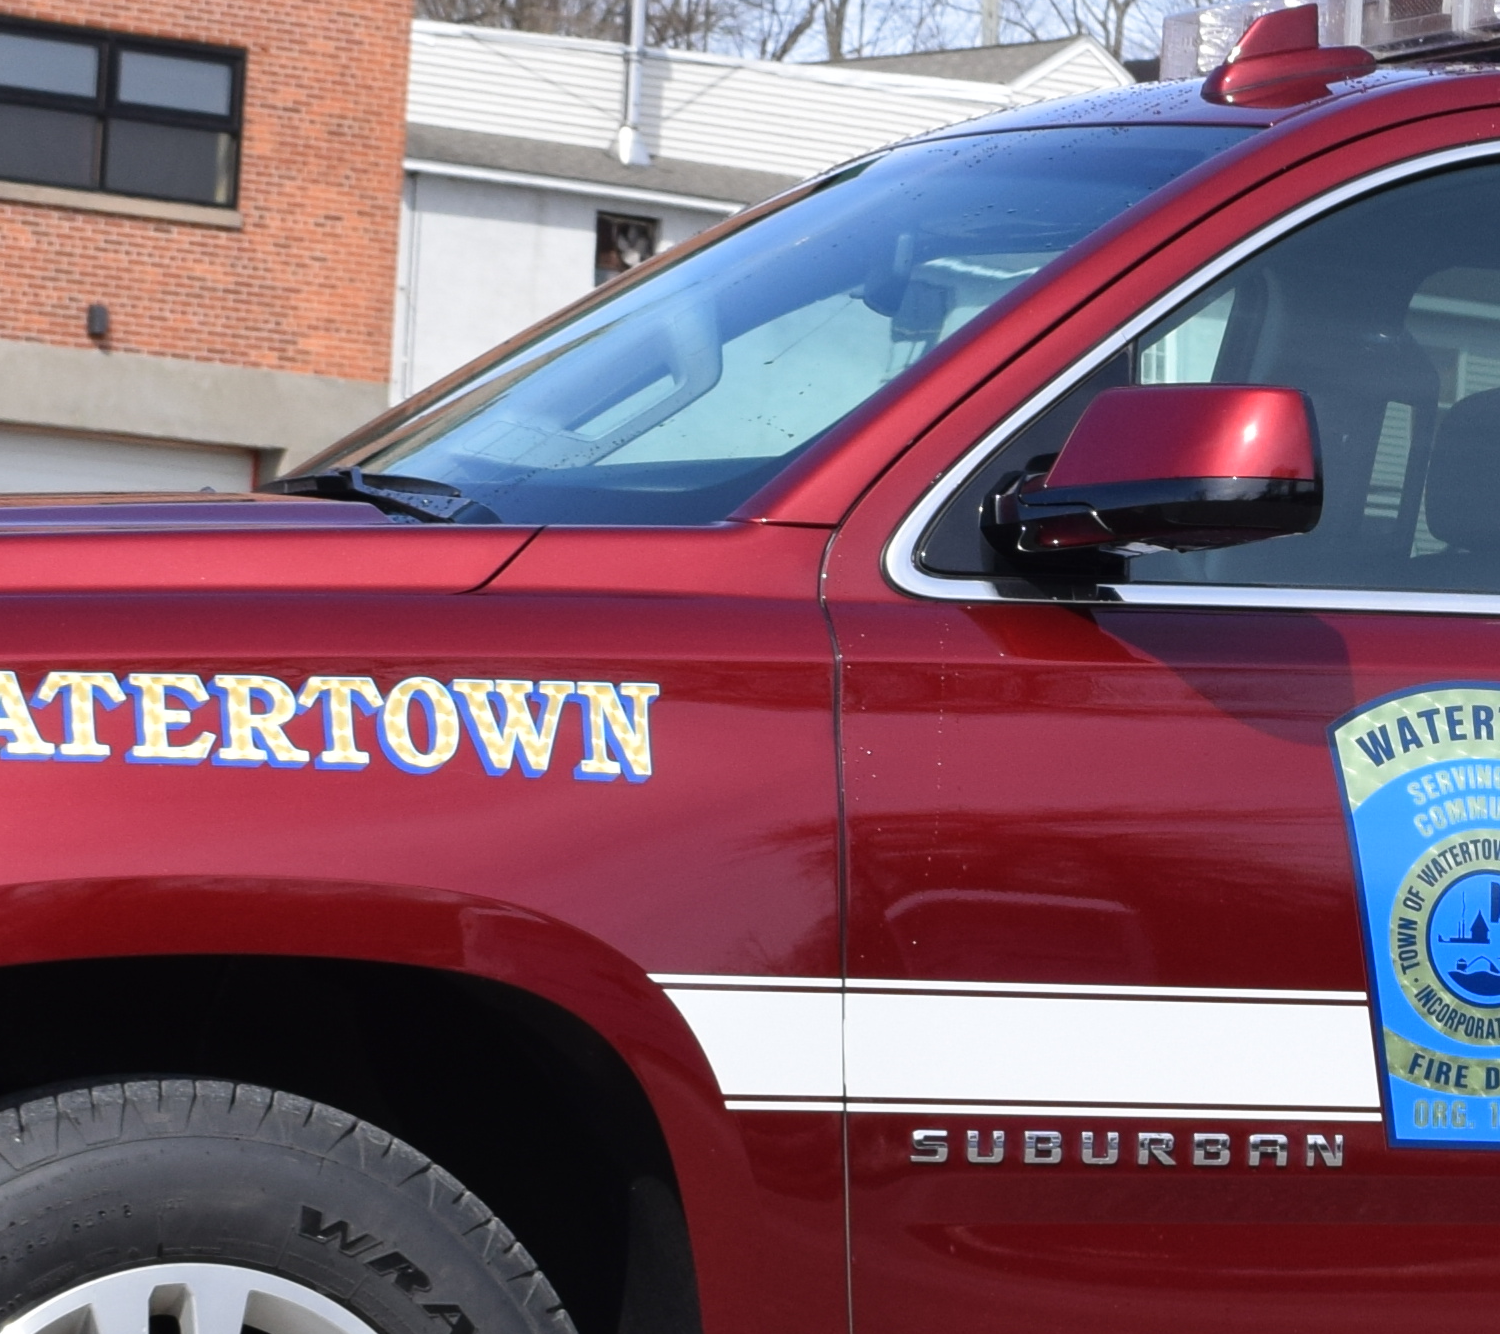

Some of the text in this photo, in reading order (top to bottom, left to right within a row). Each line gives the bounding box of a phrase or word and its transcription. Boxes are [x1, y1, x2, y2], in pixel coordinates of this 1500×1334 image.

[1402, 885, 1427, 913] OF
[1396, 916, 1421, 976] TOWN
[1408, 1052, 1470, 1089] FIRE
[1413, 1099, 1476, 1129] ORG.
[910, 1129, 1344, 1168] SUBURBAN
